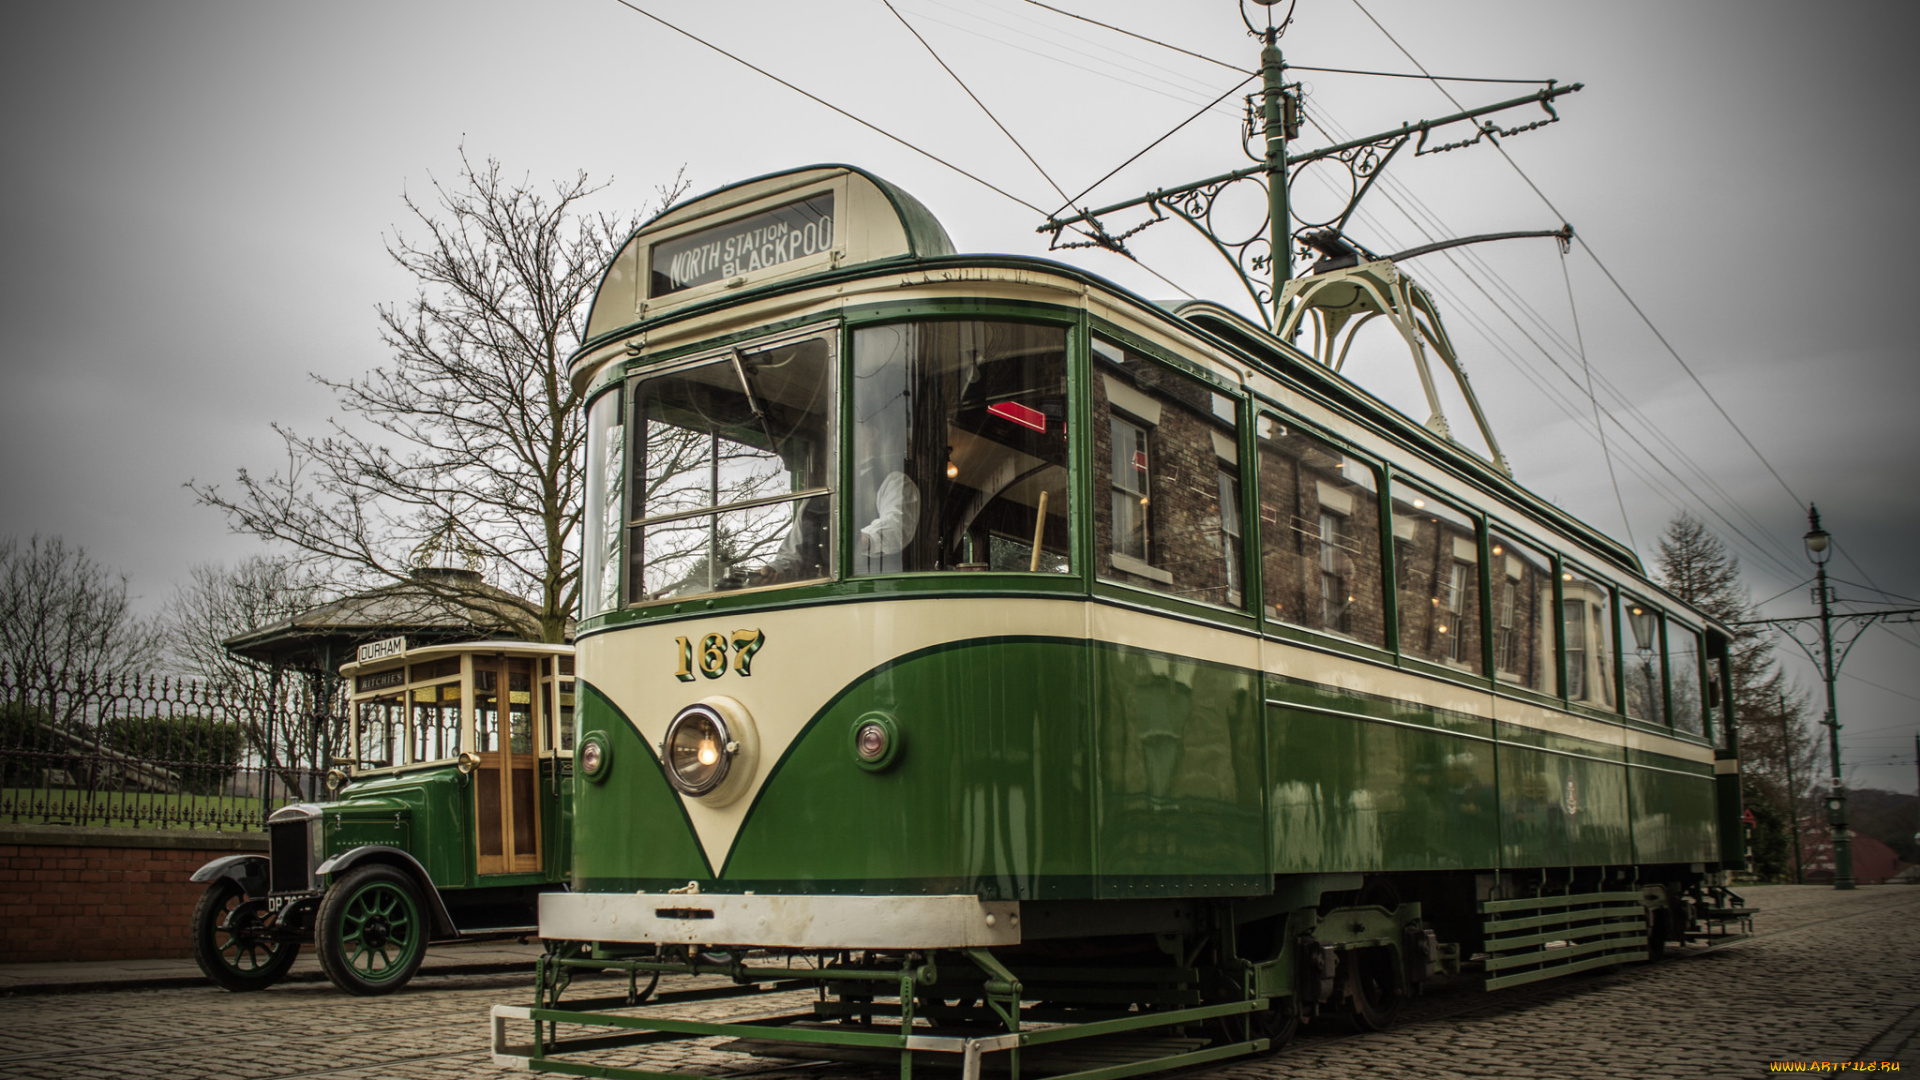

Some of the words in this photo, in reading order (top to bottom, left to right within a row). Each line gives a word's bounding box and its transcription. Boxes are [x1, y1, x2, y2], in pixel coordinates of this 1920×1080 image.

[670, 241, 721, 290] NORTH
[723, 222, 788, 262] STATION
[360, 639, 402, 660] DURHAM
[675, 628, 765, 682] 167
[361, 672, 402, 689] RITCHIES
